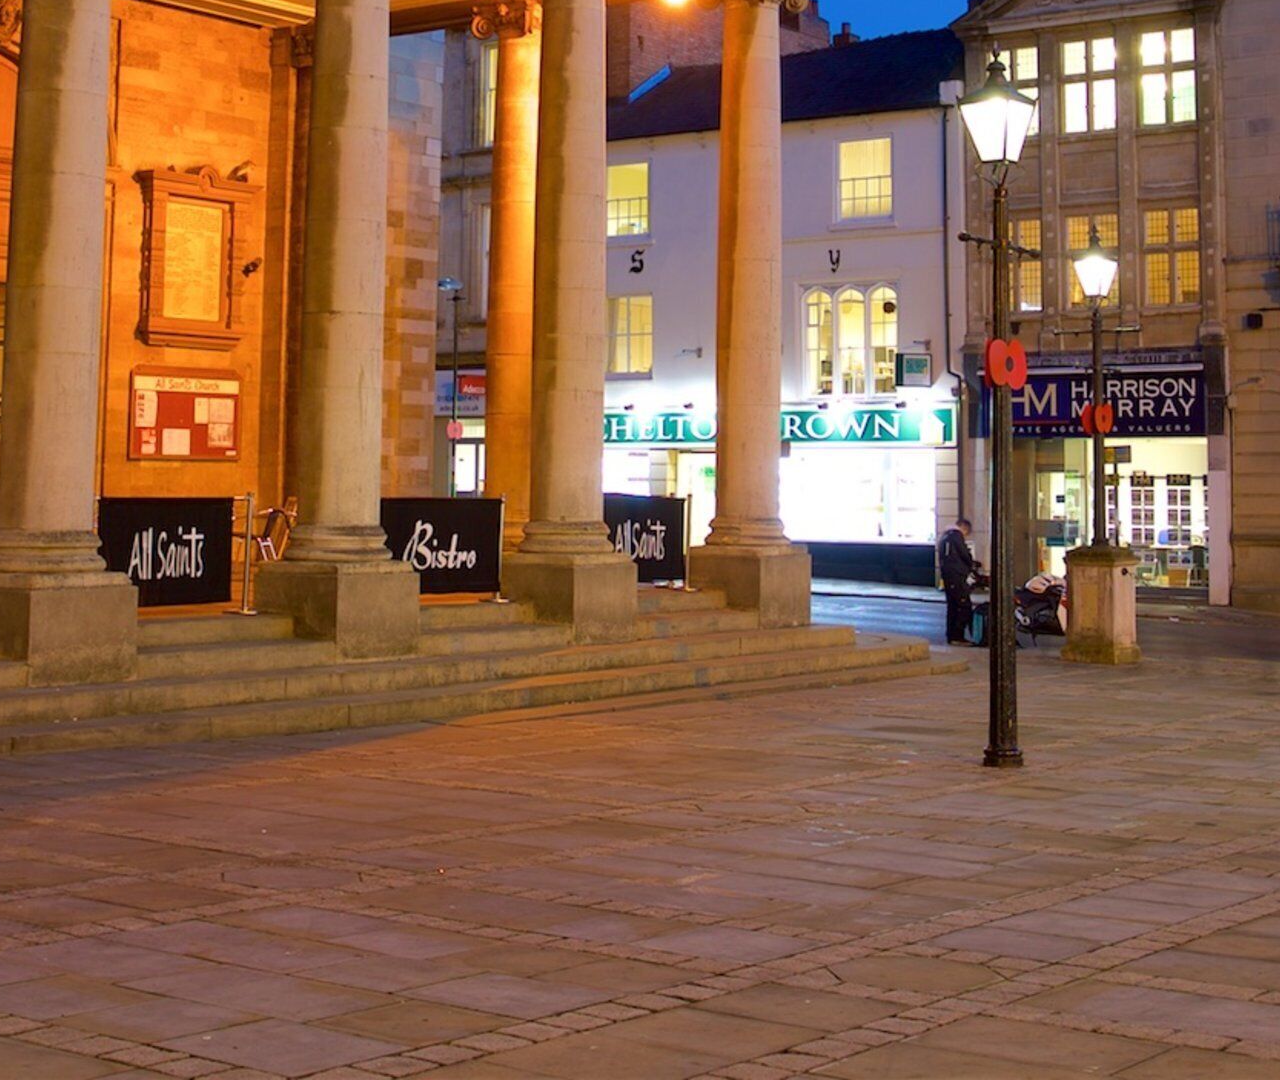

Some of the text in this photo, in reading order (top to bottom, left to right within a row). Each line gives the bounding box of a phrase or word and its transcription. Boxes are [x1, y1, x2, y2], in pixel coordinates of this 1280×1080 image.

[1071, 398, 1196, 418] MRRAY
[604, 413, 901, 440] HELTO ROWN
[1128, 423, 1192, 433] VALUERS
[127, 525, 205, 581] All Saints
[401, 519, 477, 571] Bistro
[615, 518, 667, 561] All Saints
